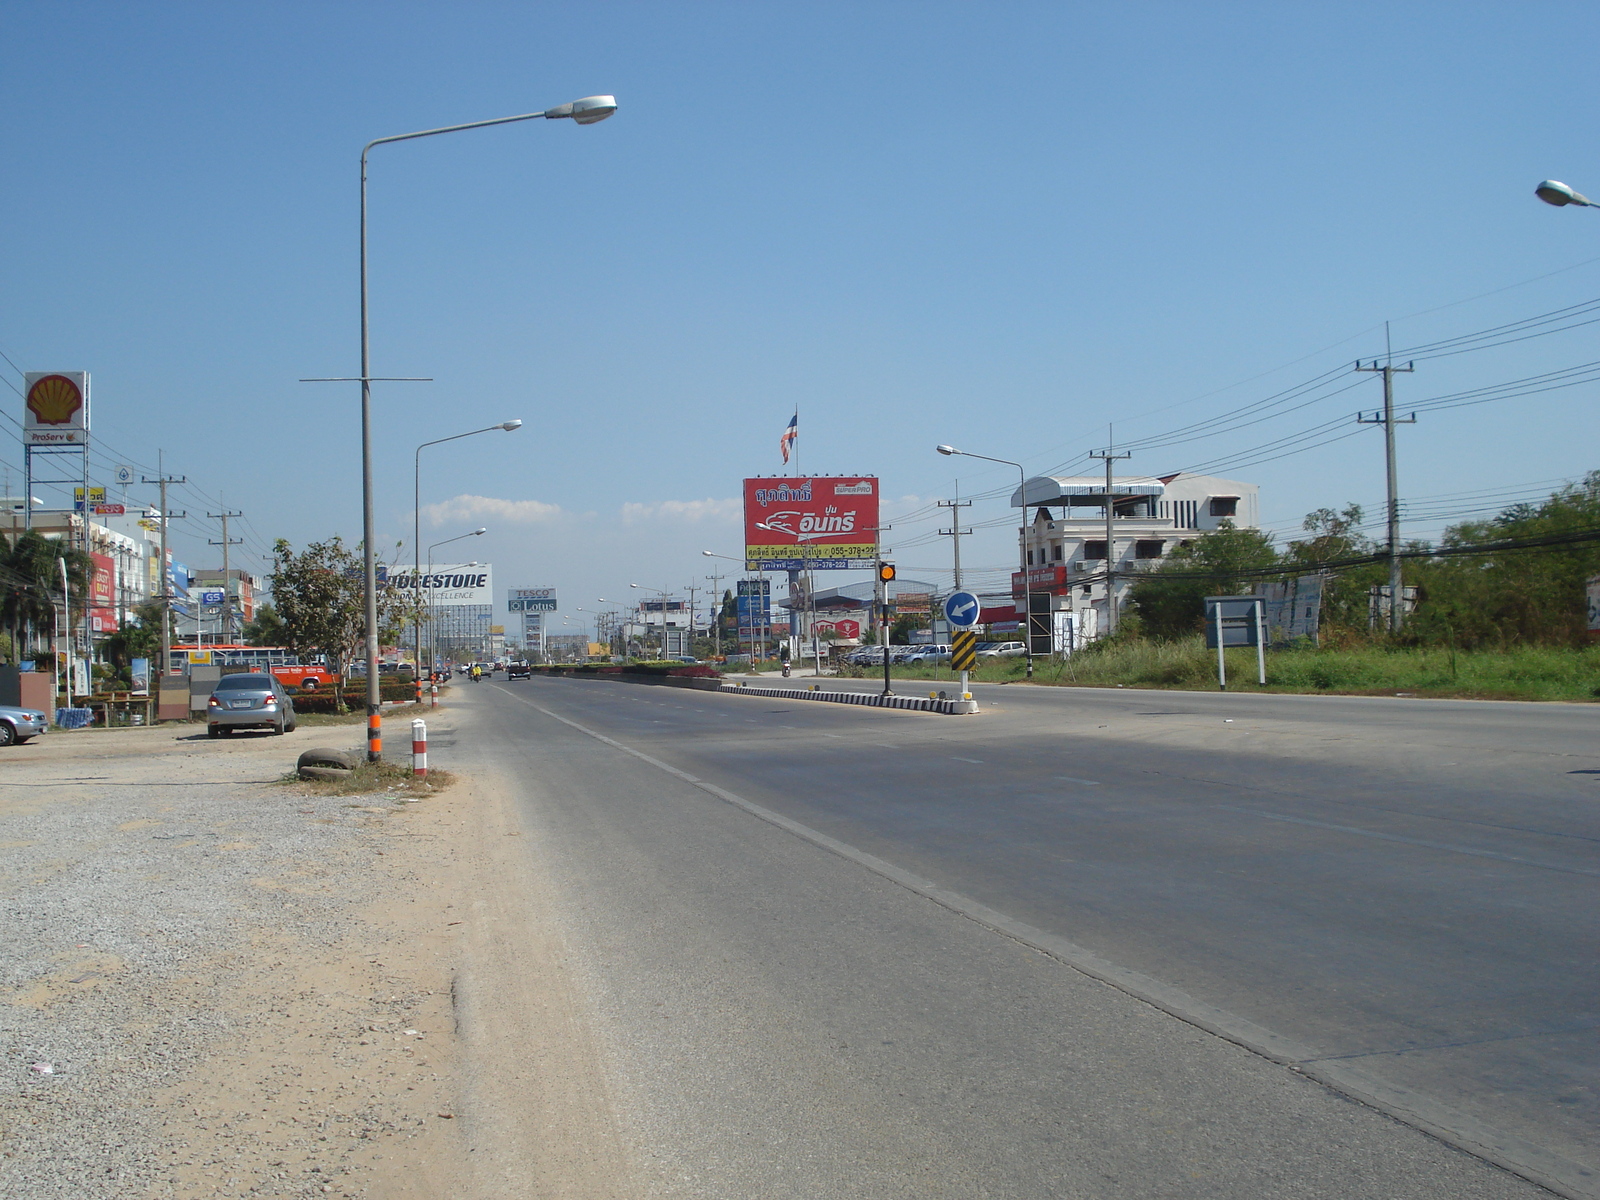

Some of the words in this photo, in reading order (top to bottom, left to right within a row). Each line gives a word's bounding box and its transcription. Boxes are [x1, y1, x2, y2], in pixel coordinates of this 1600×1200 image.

[32, 433, 65, 441] ProServ
[799, 510, 856, 532] อินทรี
[206, 593, 220, 602] GS
[516, 589, 549, 597] TESCO
[523, 600, 554, 611] Lotus
